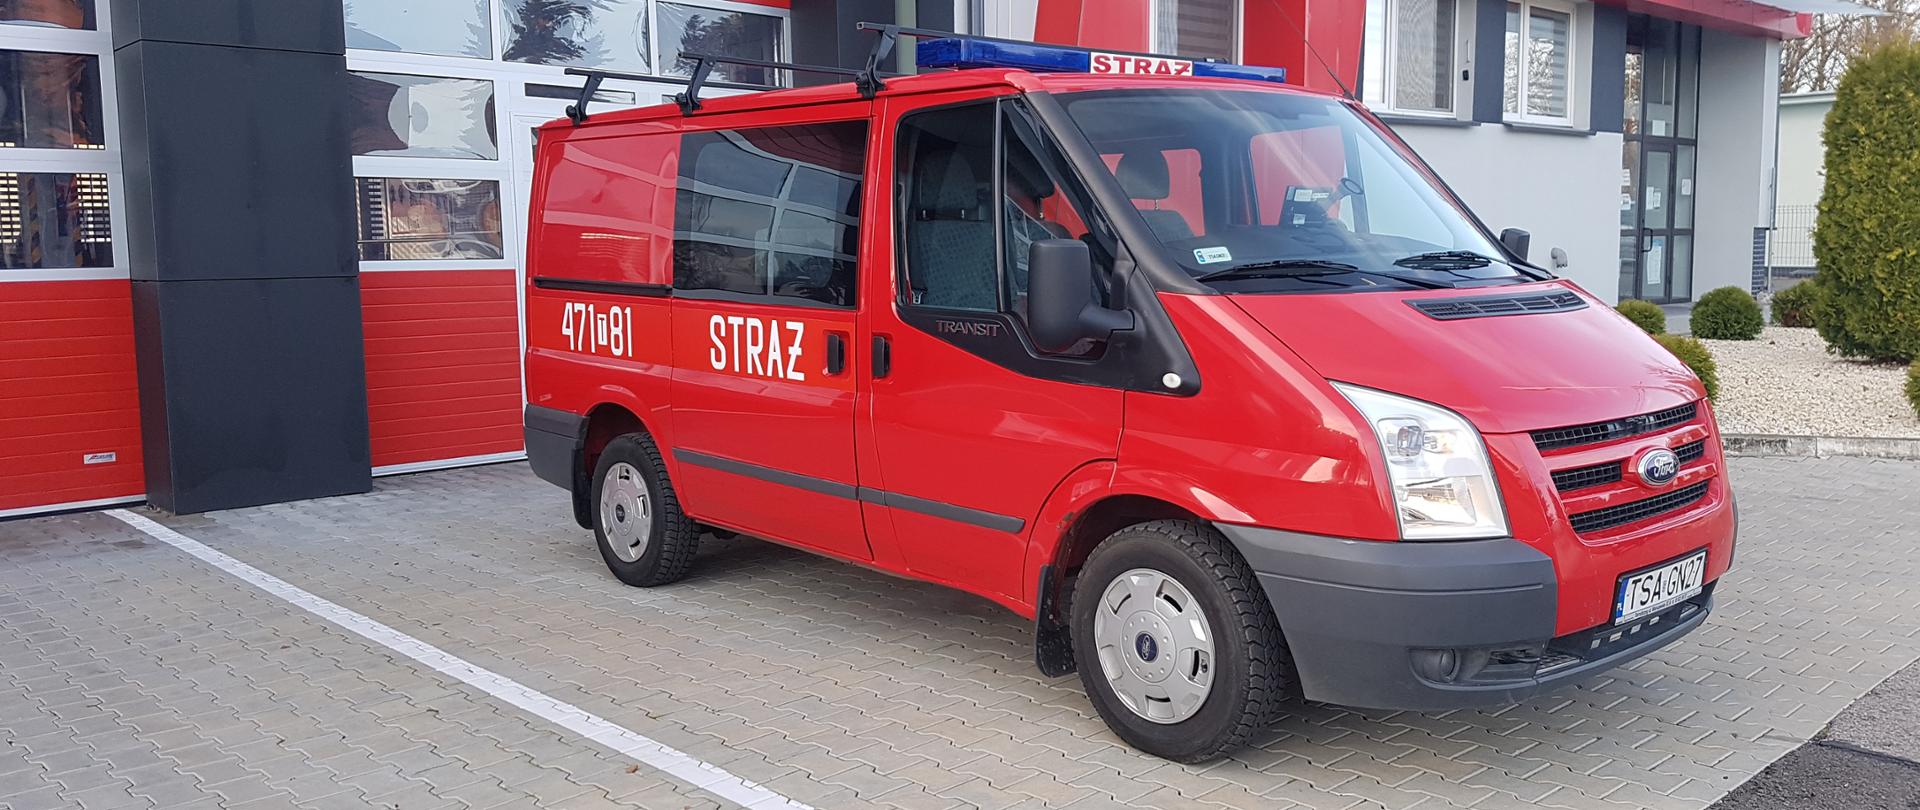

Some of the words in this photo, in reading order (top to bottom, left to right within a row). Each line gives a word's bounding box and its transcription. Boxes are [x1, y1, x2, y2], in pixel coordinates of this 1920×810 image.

[710, 315, 805, 381] STRAŻ
[936, 320, 1000, 336] TRANSIT
[1630, 571, 1663, 610] TSA
[1667, 556, 1703, 596] GN27
